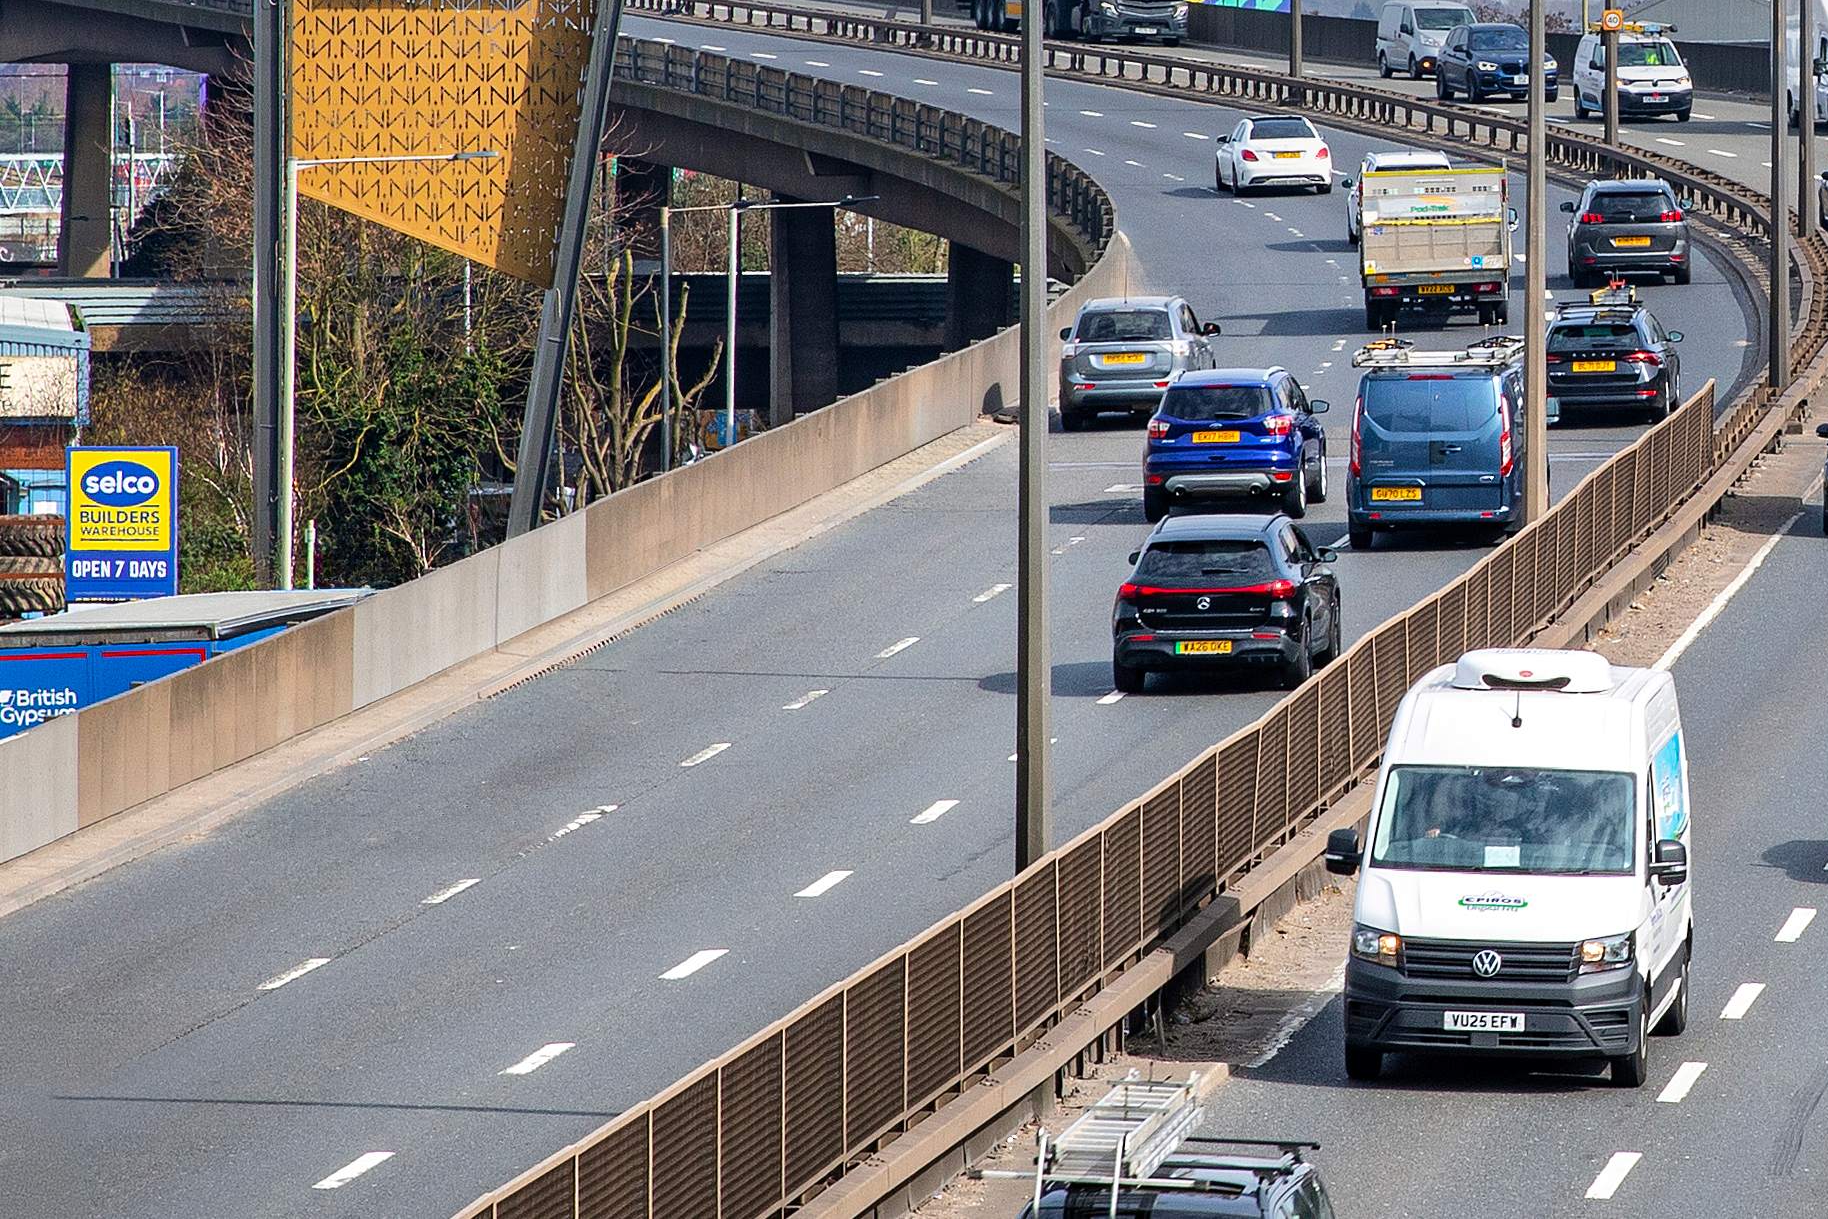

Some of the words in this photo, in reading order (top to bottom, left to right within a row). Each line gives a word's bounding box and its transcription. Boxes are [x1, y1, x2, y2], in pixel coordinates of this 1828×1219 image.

[86, 471, 155, 494] selco
[80, 510, 160, 524] BUILDERS
[80, 526, 159, 536] WAREHOUSE
[72, 560, 110, 578] OPEN
[115, 560, 126, 578] 7
[129, 560, 166, 578] DAYS
[16, 687, 77, 707] British
[1451, 1013, 1487, 1029] VU25
[1490, 1014, 1518, 1030] EFW
